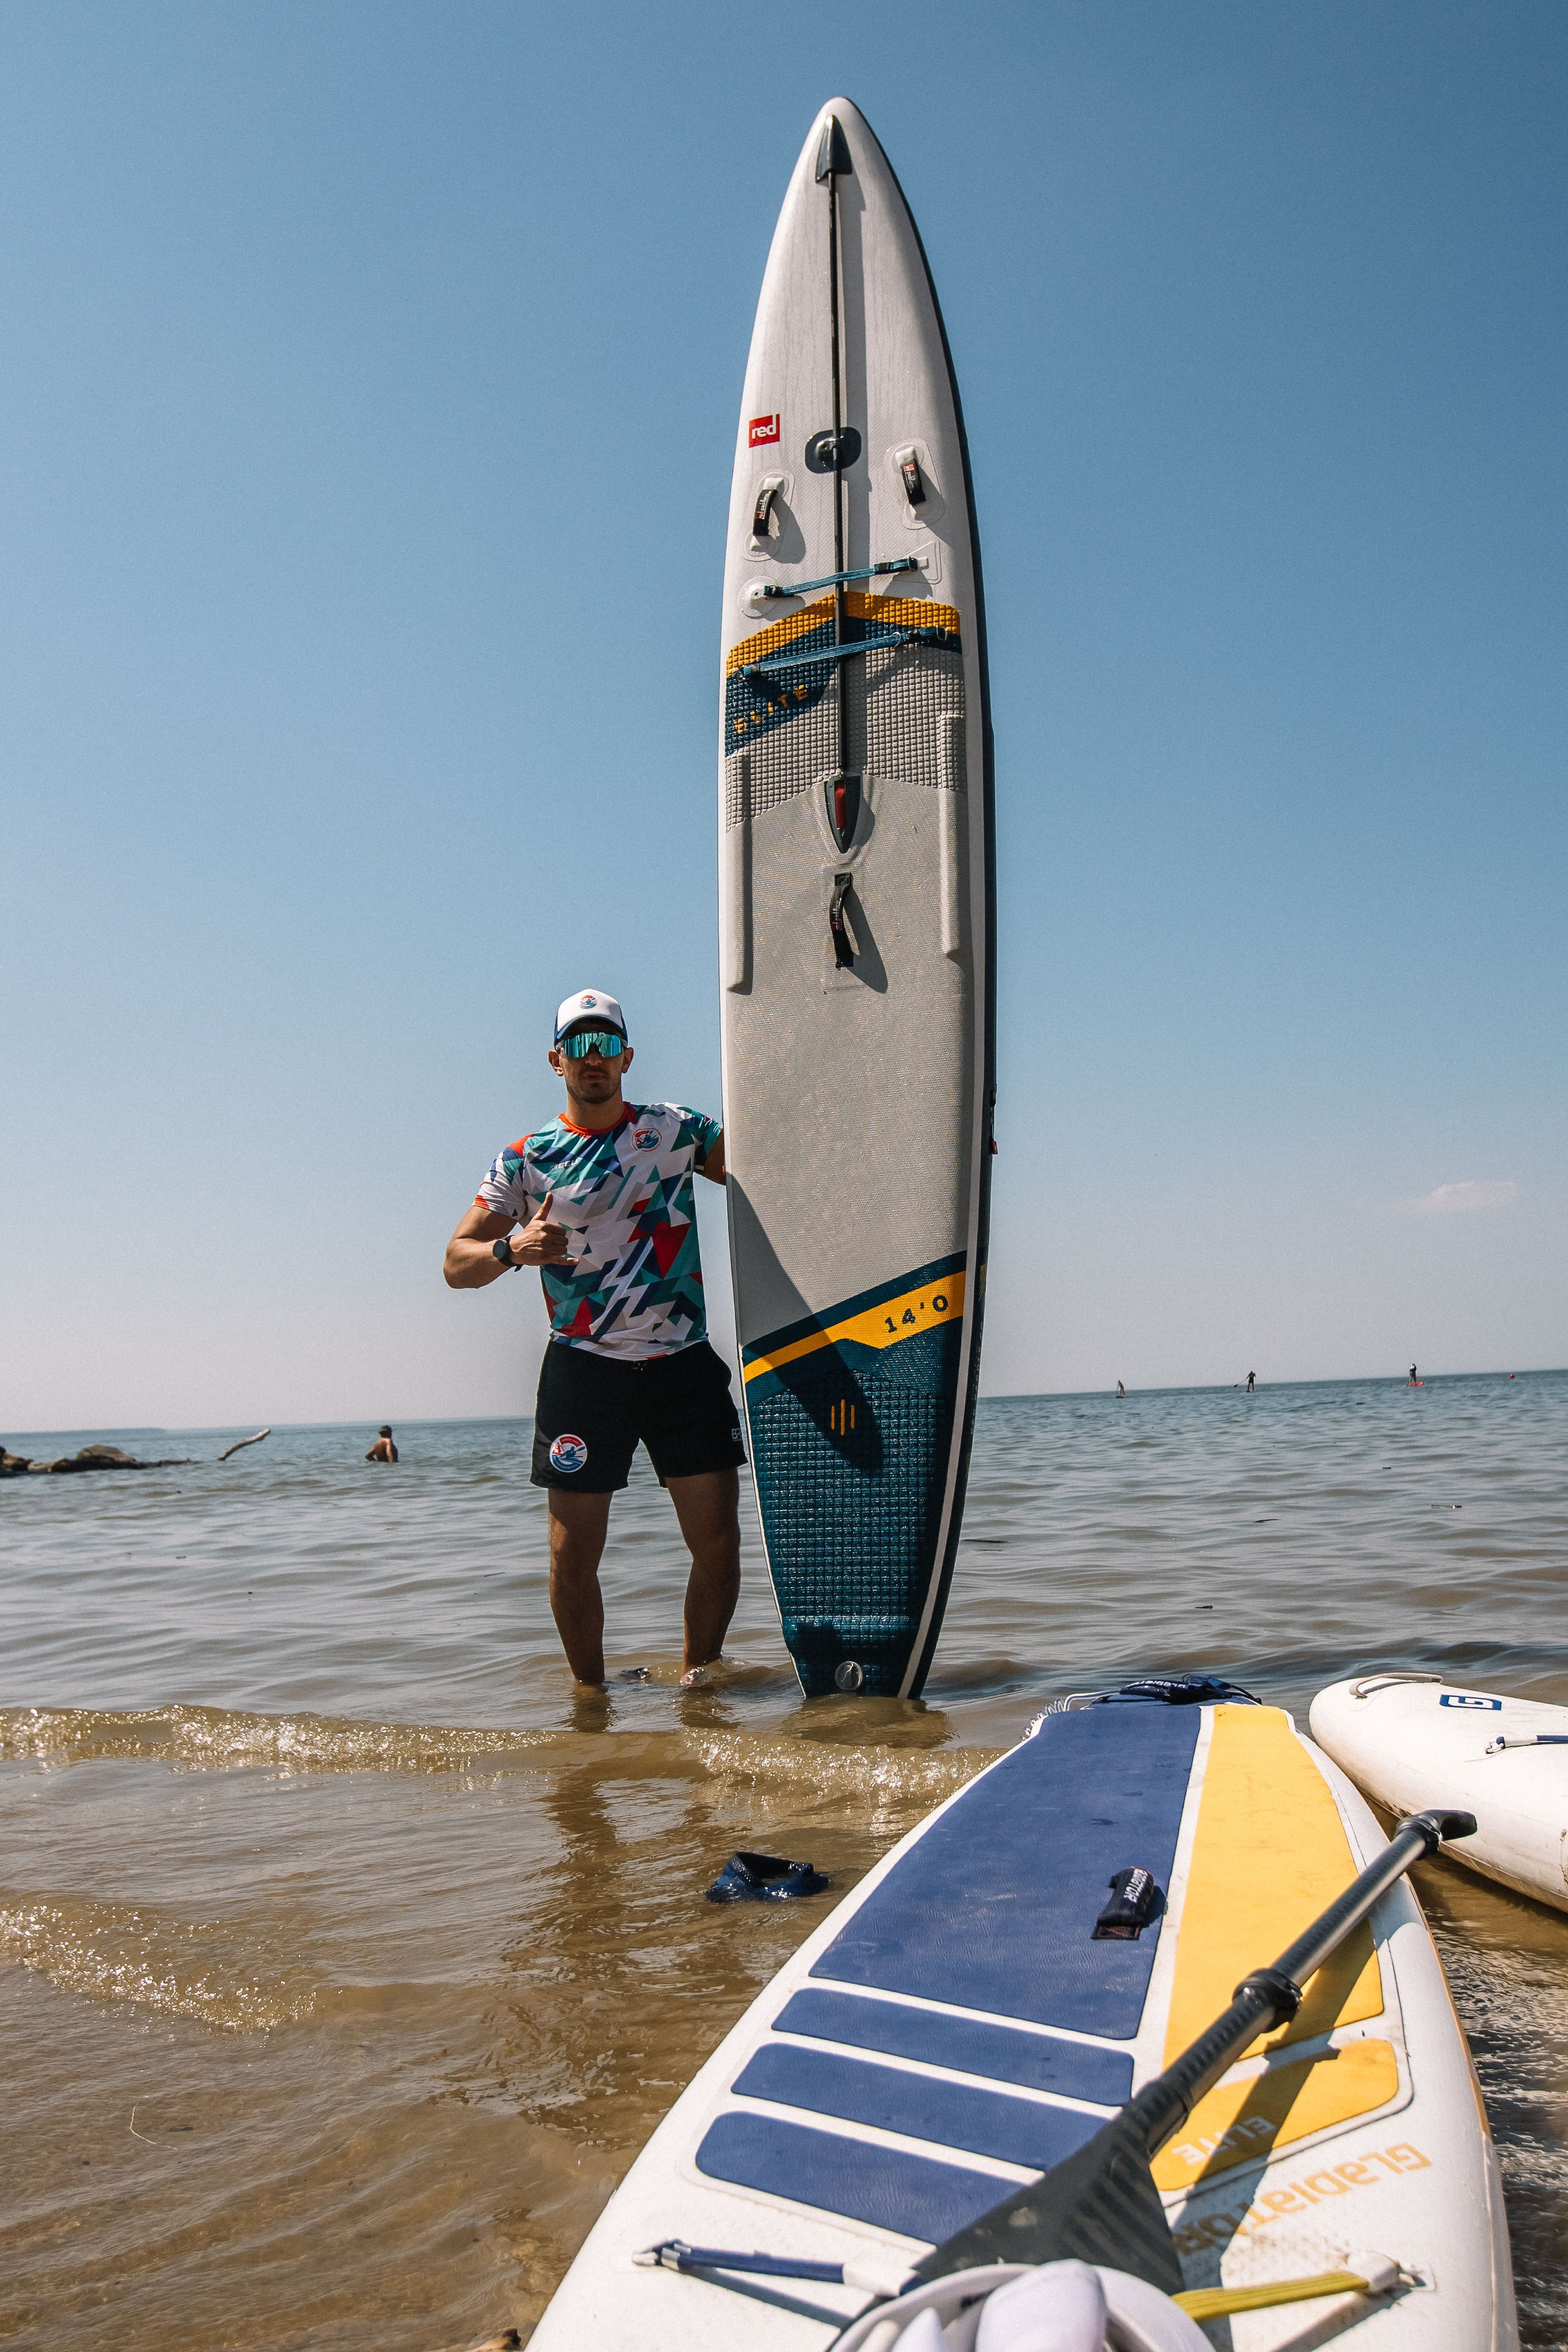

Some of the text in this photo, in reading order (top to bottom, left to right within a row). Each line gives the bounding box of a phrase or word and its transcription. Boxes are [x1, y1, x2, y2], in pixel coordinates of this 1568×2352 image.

[752, 414, 777, 439] red
[734, 685, 807, 734] ELITE
[1172, 2116, 1276, 2165] ELITE
